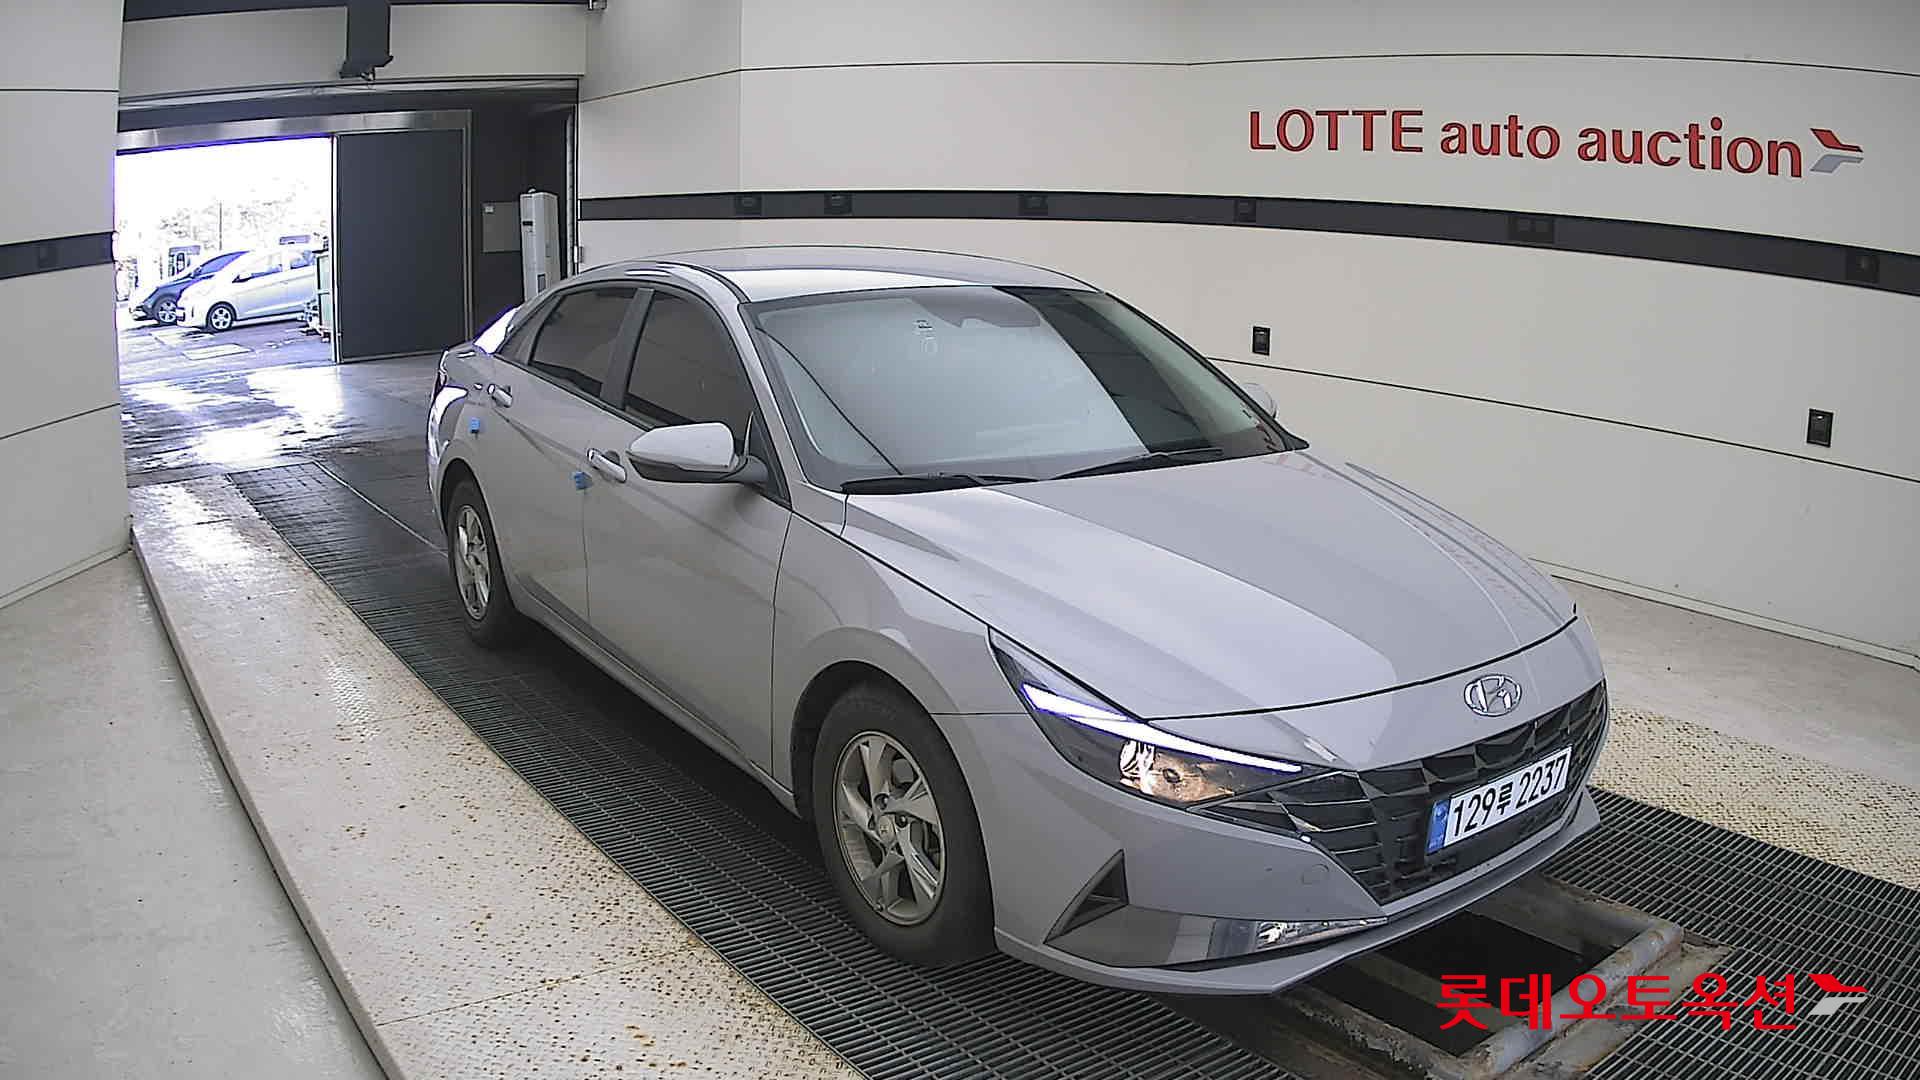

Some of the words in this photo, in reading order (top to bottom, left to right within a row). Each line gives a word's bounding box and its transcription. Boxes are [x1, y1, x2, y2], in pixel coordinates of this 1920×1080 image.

[1248, 109, 1424, 152] LOTTE
[1440, 115, 1561, 160] auto
[1577, 117, 1803, 178] auction
[1453, 781, 1513, 836] 129루
[1516, 753, 1568, 809] 2237
